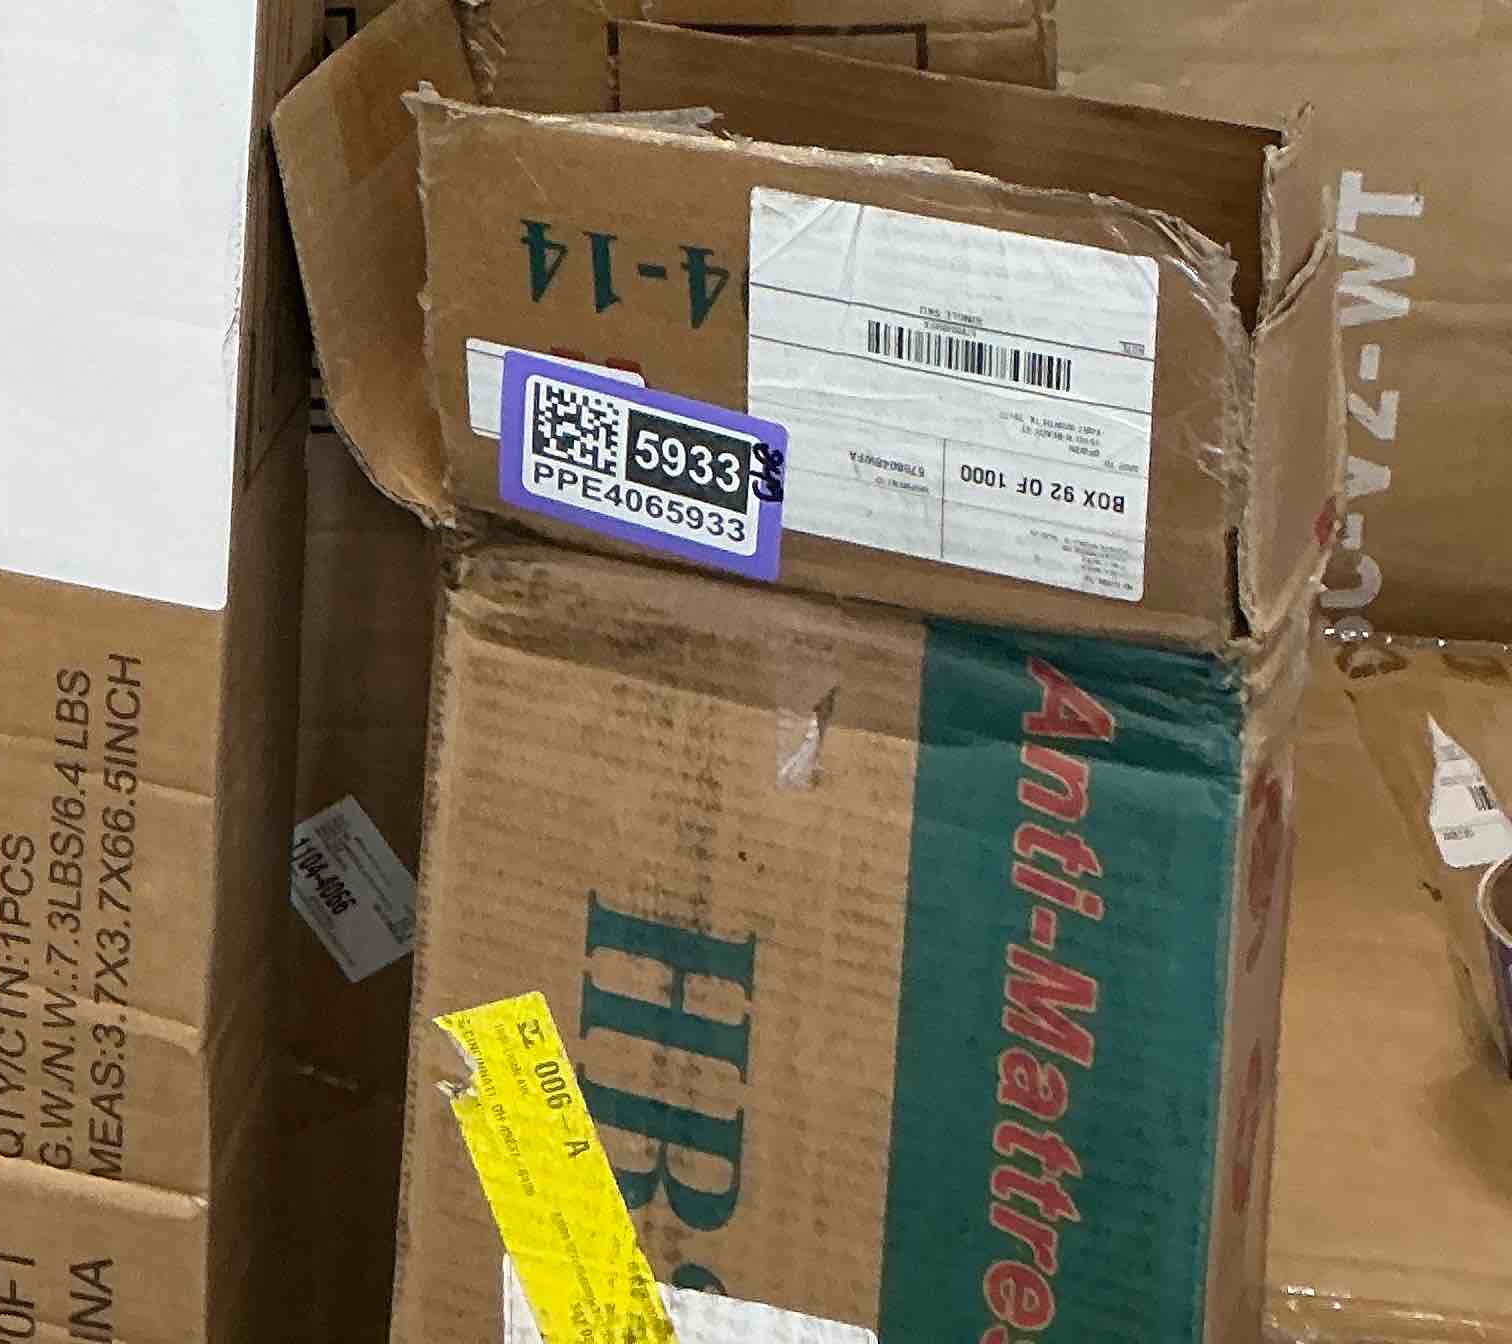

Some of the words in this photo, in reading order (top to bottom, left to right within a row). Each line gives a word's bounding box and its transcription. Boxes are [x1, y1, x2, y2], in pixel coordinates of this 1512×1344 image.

[633, 428, 743, 493] 5933
[959, 463, 1006, 489] 1000
[533, 461, 747, 544] PPE4065933
[1015, 477, 1044, 499] OF
[1049, 482, 1074, 505] 92
[1084, 486, 1125, 513] BOX
[56, 667, 92, 752] LBS
[981, 658, 1119, 1344] Anti-Mattre
